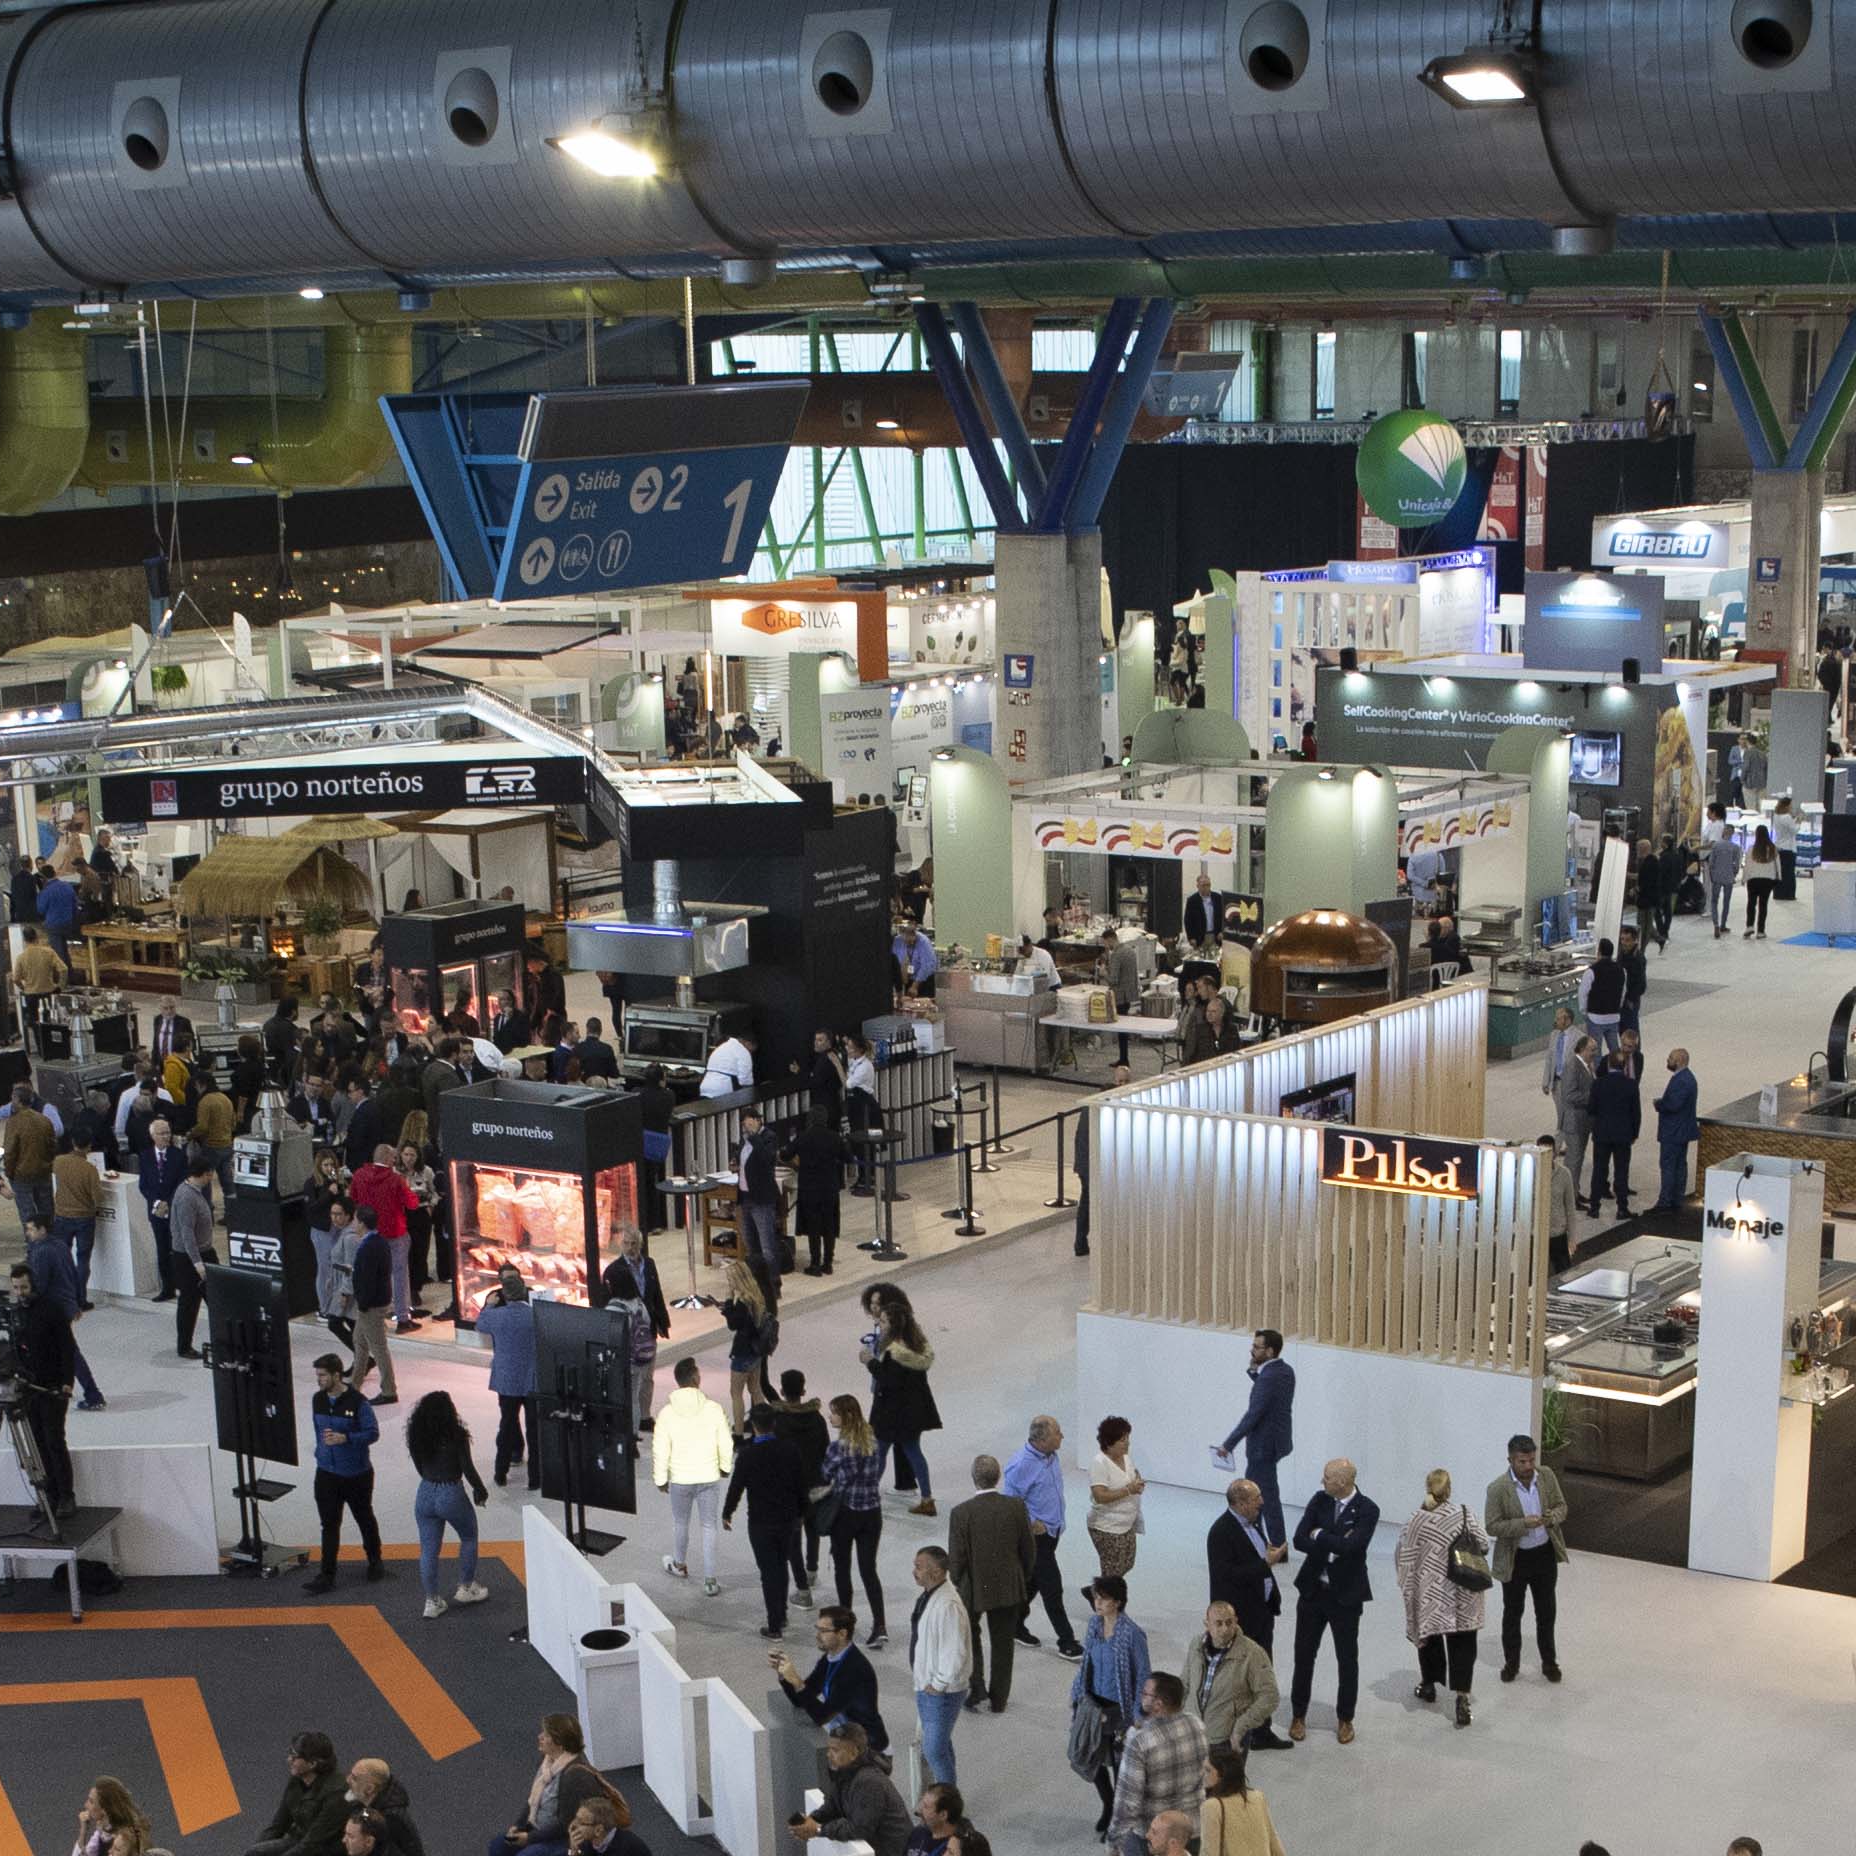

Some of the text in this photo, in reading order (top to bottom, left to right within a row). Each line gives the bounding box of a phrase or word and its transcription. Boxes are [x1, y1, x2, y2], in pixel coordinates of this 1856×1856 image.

[575, 470, 620, 492] Salida
[663, 464, 688, 511] 2
[570, 501, 596, 520] Exit
[721, 479, 752, 563] 1
[1614, 535, 1706, 556] GIRBAU
[763, 608, 842, 629] GRESILVA
[220, 771, 424, 808] grupo norteños
[454, 924, 506, 945] grupo norteños
[472, 1122, 553, 1141] grupo norteños
[1337, 1134, 1463, 1191] Pilsa
[1707, 1210, 1784, 1239] Menaje
